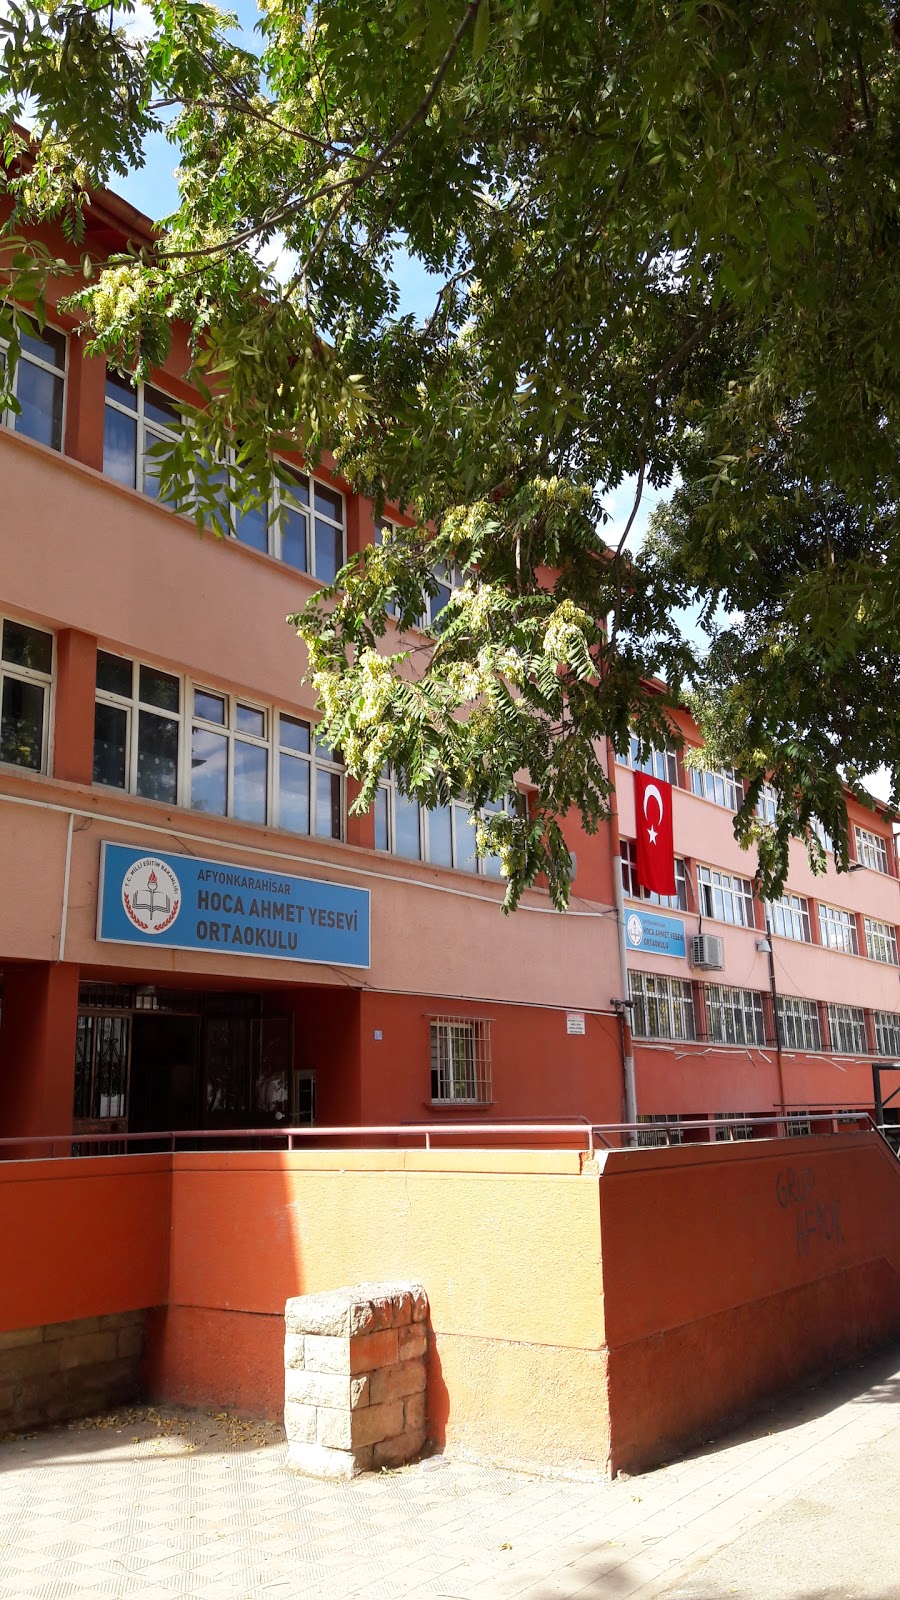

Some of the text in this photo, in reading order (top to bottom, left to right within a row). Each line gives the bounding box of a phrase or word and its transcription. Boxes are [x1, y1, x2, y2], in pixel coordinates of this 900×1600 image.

[197, 869, 291, 896] AFYONKARAHİSAR
[197, 889, 358, 932] HOCA AHMET YESEVİ
[196, 920, 298, 951] ORTAOKULU
